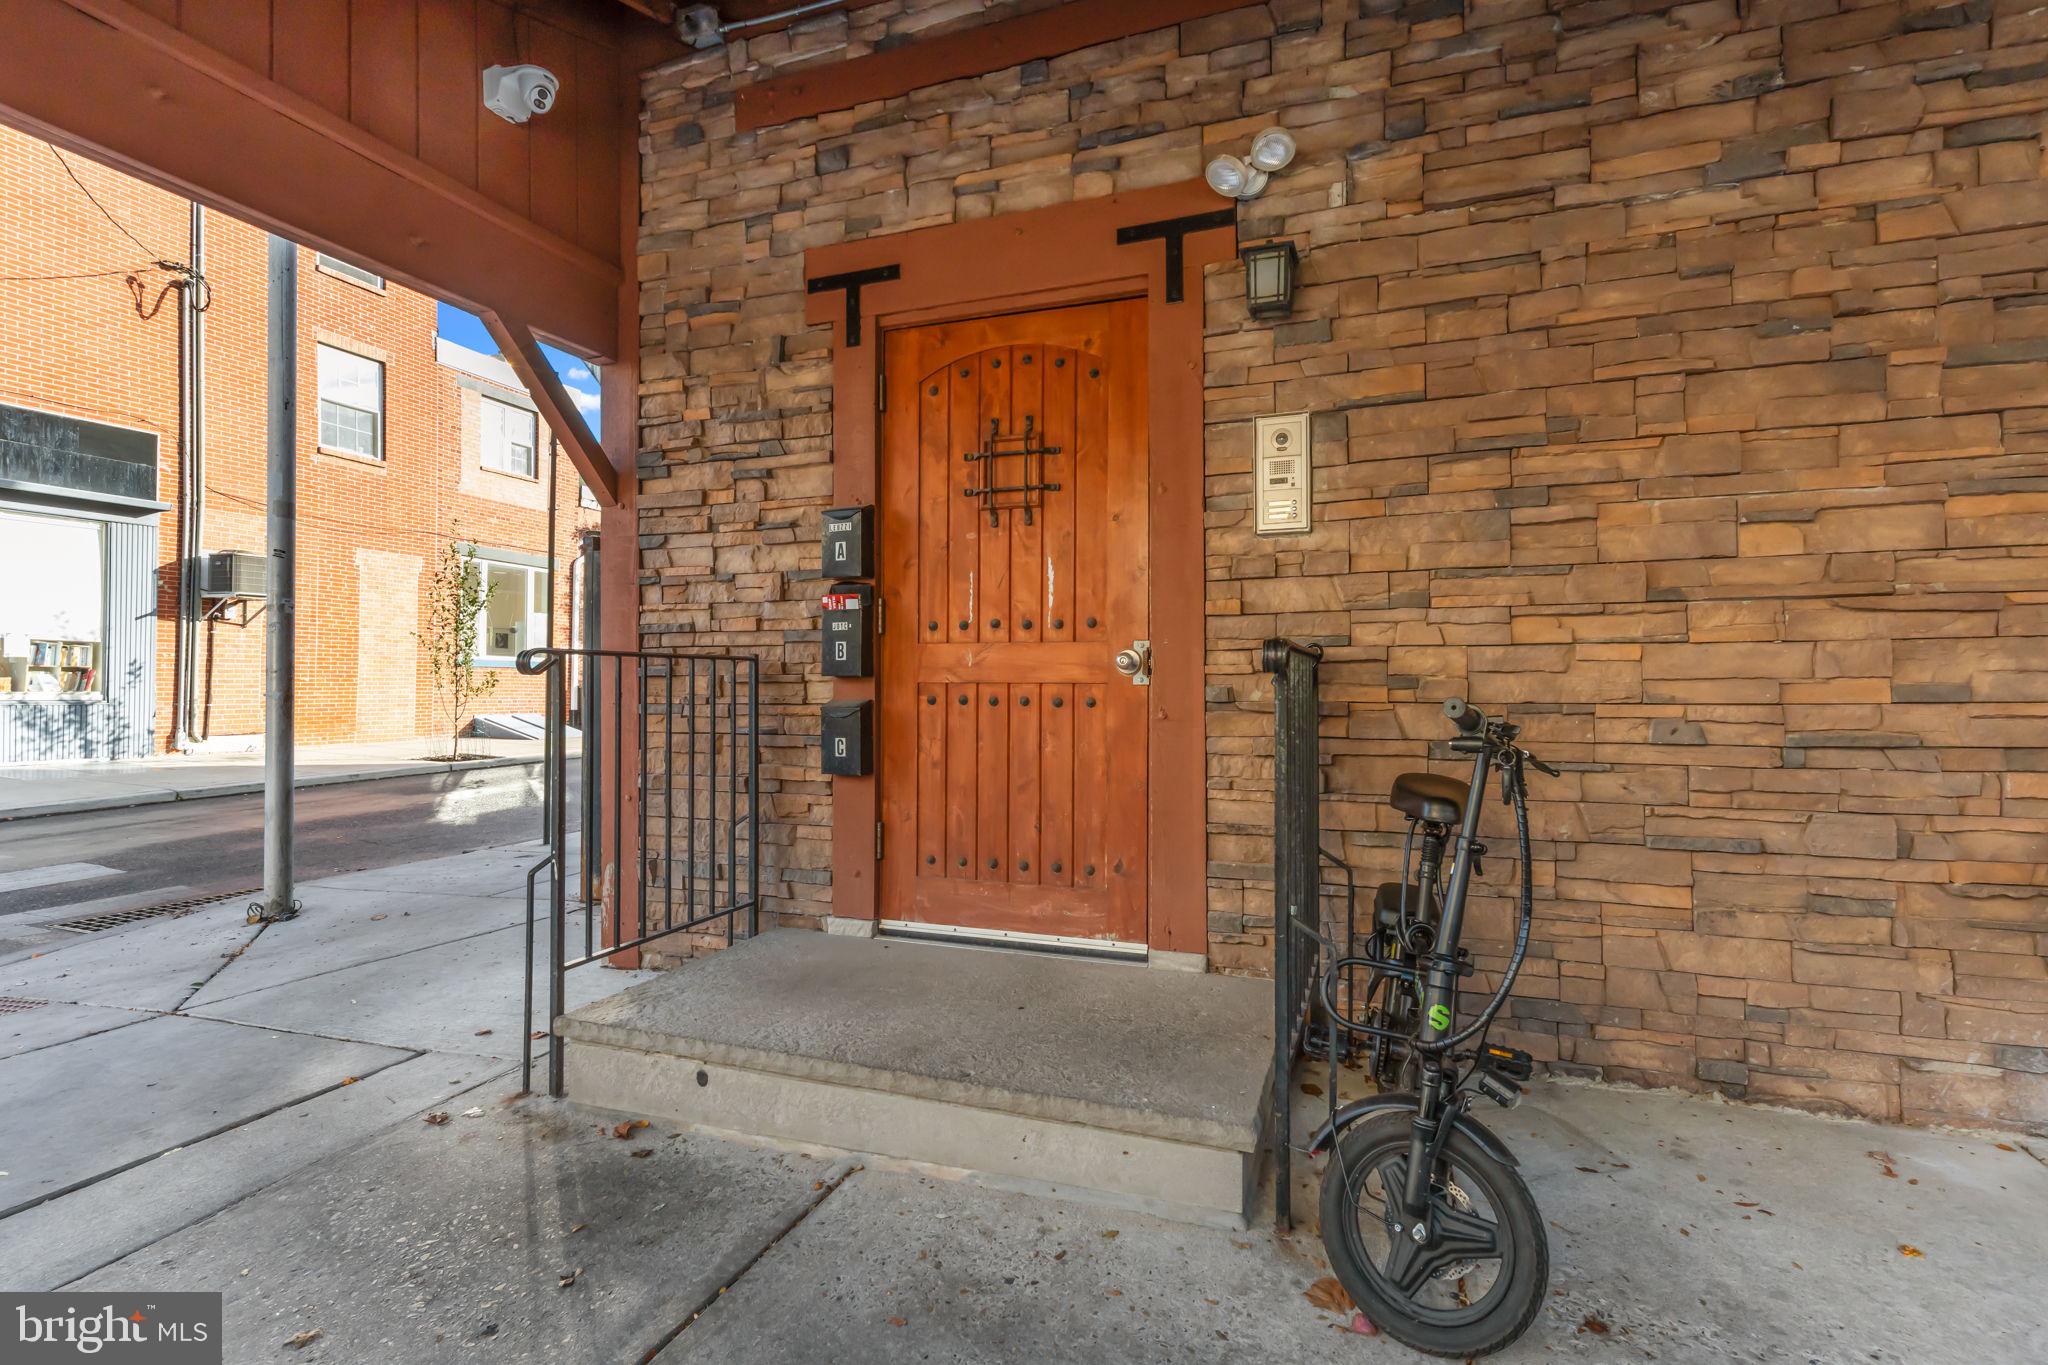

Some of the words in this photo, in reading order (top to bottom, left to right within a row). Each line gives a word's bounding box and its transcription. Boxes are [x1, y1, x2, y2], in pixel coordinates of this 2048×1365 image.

[837, 542, 845, 560] A
[837, 642, 845, 660] B
[836, 738, 844, 756] C
[1428, 1003, 1450, 1031] S
